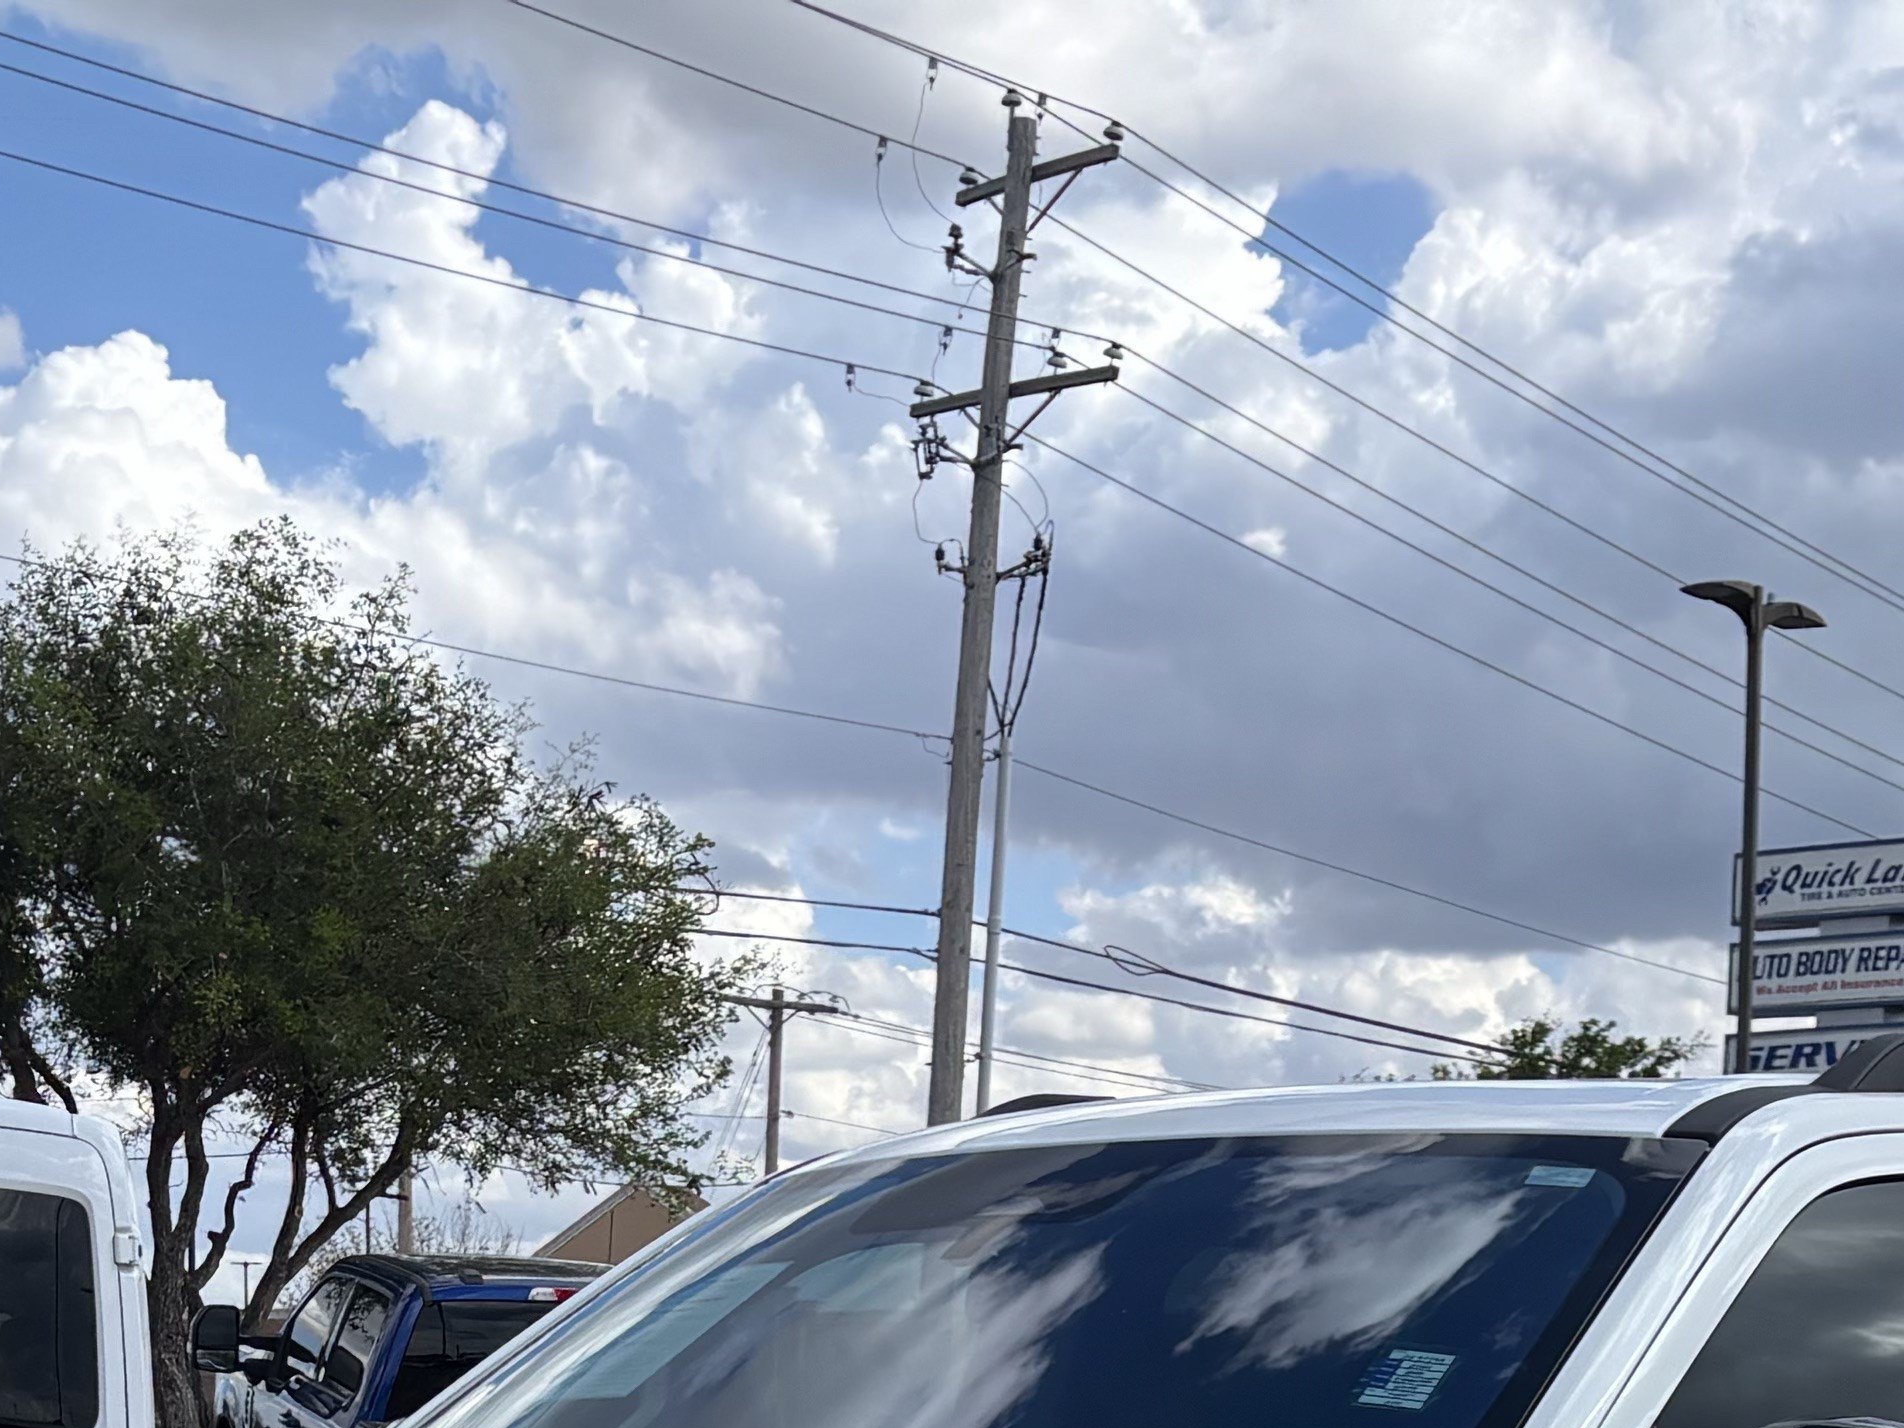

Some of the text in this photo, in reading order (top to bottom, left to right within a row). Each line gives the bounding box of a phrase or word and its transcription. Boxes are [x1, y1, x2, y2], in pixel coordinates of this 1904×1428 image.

[1781, 860, 1861, 893] Quick
[1800, 891, 1823, 902] TIRE
[1836, 887, 1867, 899] AUTO
[1752, 953, 1792, 980] UTO
[1796, 948, 1855, 978] BODY
